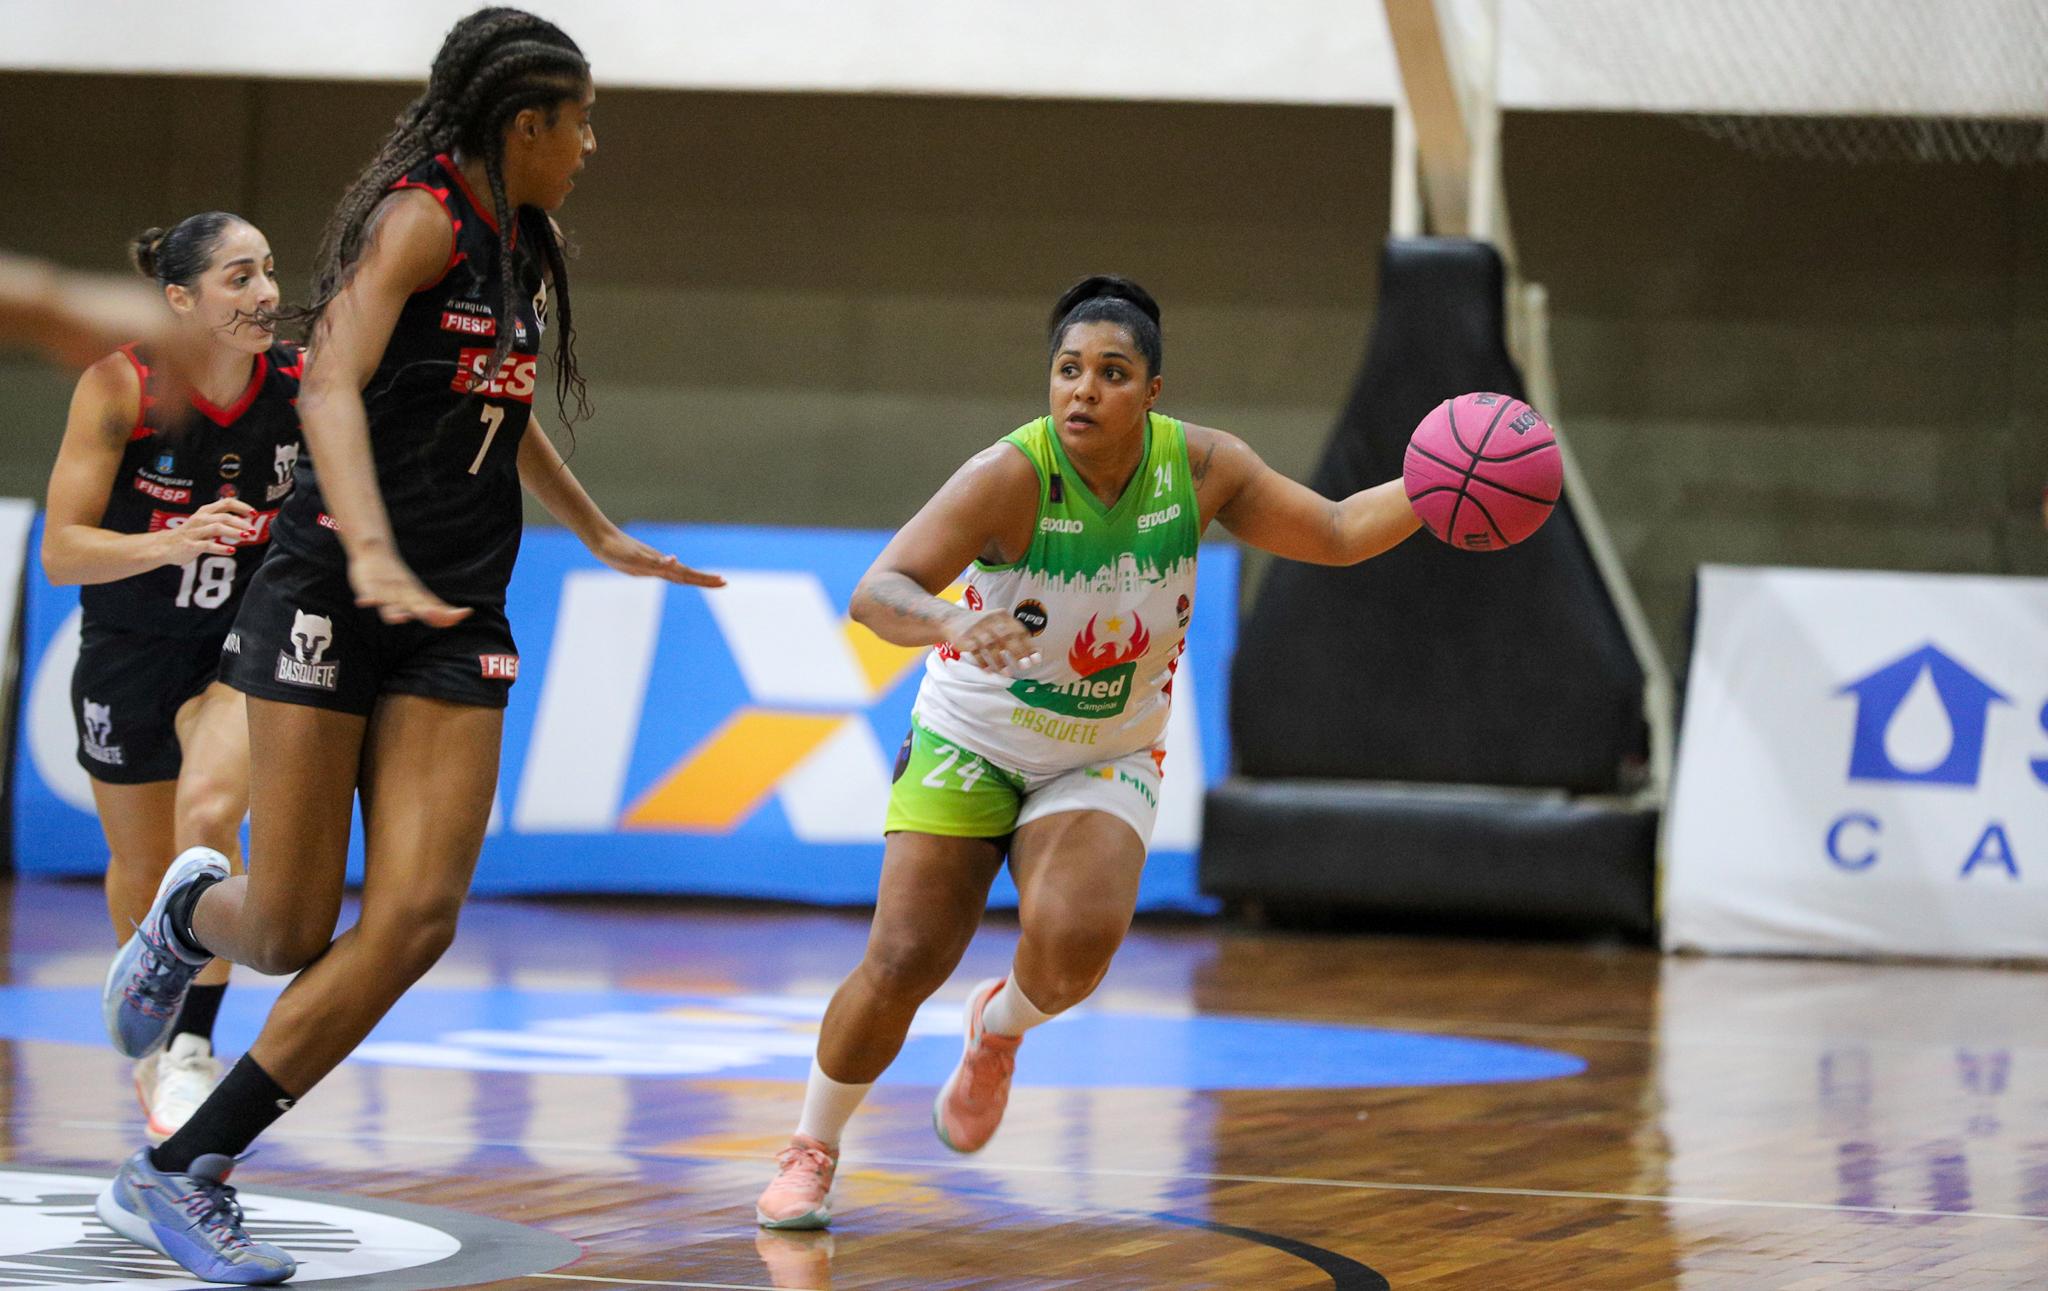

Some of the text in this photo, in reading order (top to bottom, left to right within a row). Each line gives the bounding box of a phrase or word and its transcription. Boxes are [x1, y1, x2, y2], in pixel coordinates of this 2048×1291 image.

[446, 313, 492, 333] FIESP
[468, 403, 505, 475] 7
[138, 480, 187, 502] FIESP
[1153, 461, 1172, 498] 24
[175, 556, 237, 609] 18
[278, 656, 336, 688] BASQUETE
[1025, 674, 1126, 699] med
[1011, 707, 1099, 746] BASQUETE
[921, 744, 985, 793] 24
